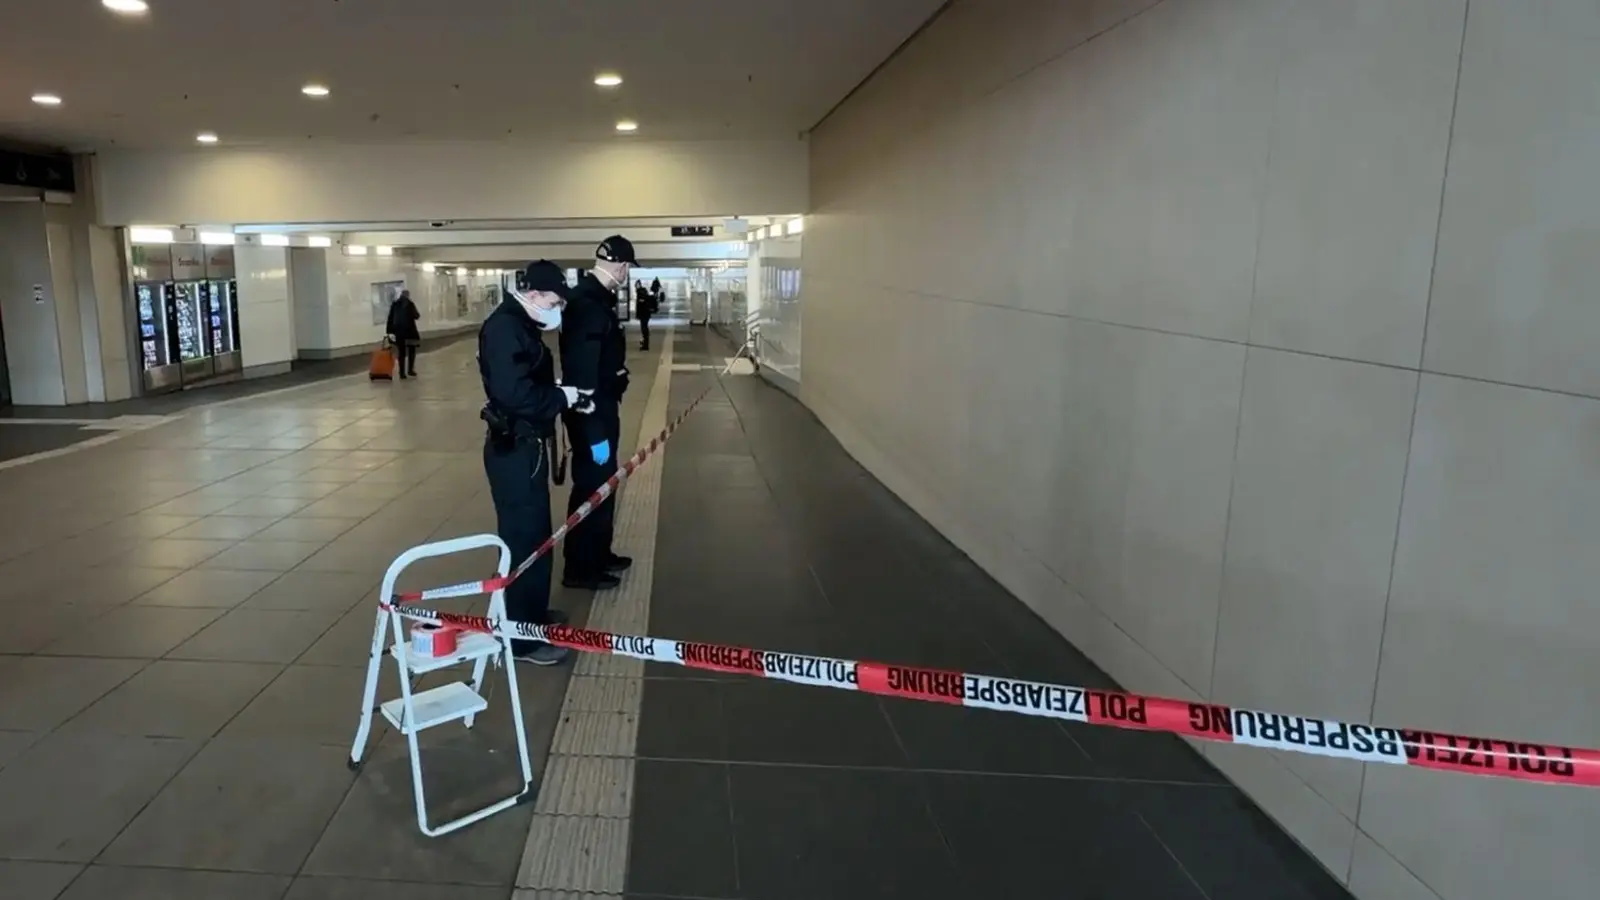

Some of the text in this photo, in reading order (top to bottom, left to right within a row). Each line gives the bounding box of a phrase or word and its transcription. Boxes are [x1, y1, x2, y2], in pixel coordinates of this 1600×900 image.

[675, 642, 858, 684] POLIZEIABSPERRUNG
[887, 667, 1147, 724] POLIZEIABSPERRUNG
[1188, 704, 1574, 776] POLIZEIABSPERRUNG
